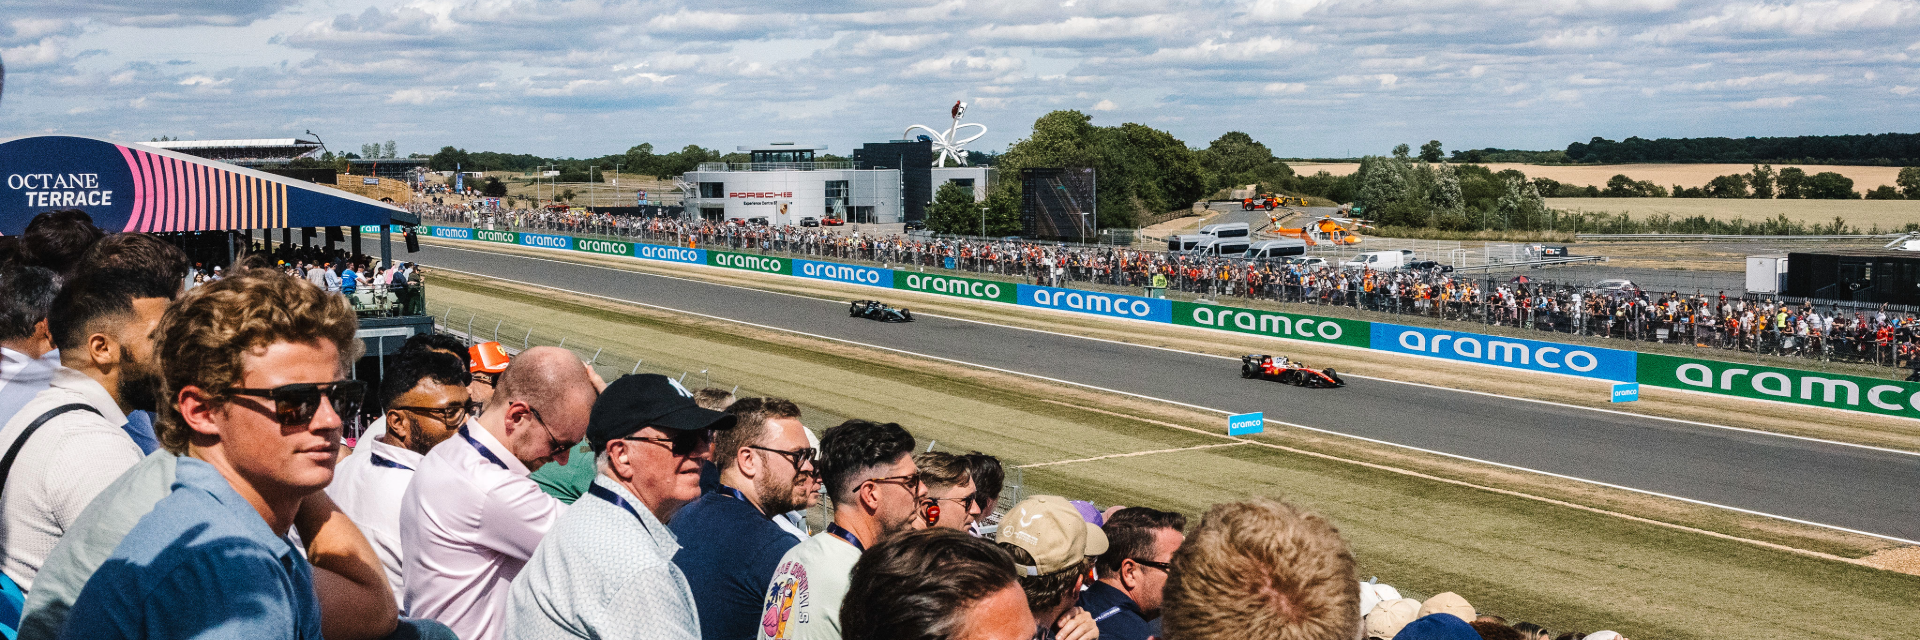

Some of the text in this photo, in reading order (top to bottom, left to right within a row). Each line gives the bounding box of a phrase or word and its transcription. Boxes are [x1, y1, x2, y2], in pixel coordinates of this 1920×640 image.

[8, 174, 99, 189] OCTANE
[25, 191, 112, 206] TERRACE
[436, 227, 468, 239] aramco
[478, 230, 514, 243] aramco
[525, 235, 566, 248] aramco
[579, 238, 627, 255] aramco
[642, 244, 698, 262] aramco
[715, 253, 781, 272] aramco
[803, 262, 880, 284] aramco
[906, 274, 1000, 299] aramco
[1033, 289, 1150, 317] aramco
[1192, 306, 1342, 340] aramco
[1399, 330, 1598, 372] aramco
[1615, 389, 1637, 397] aramco
[1676, 363, 1920, 413] aramc
[1231, 419, 1261, 429] aramco
